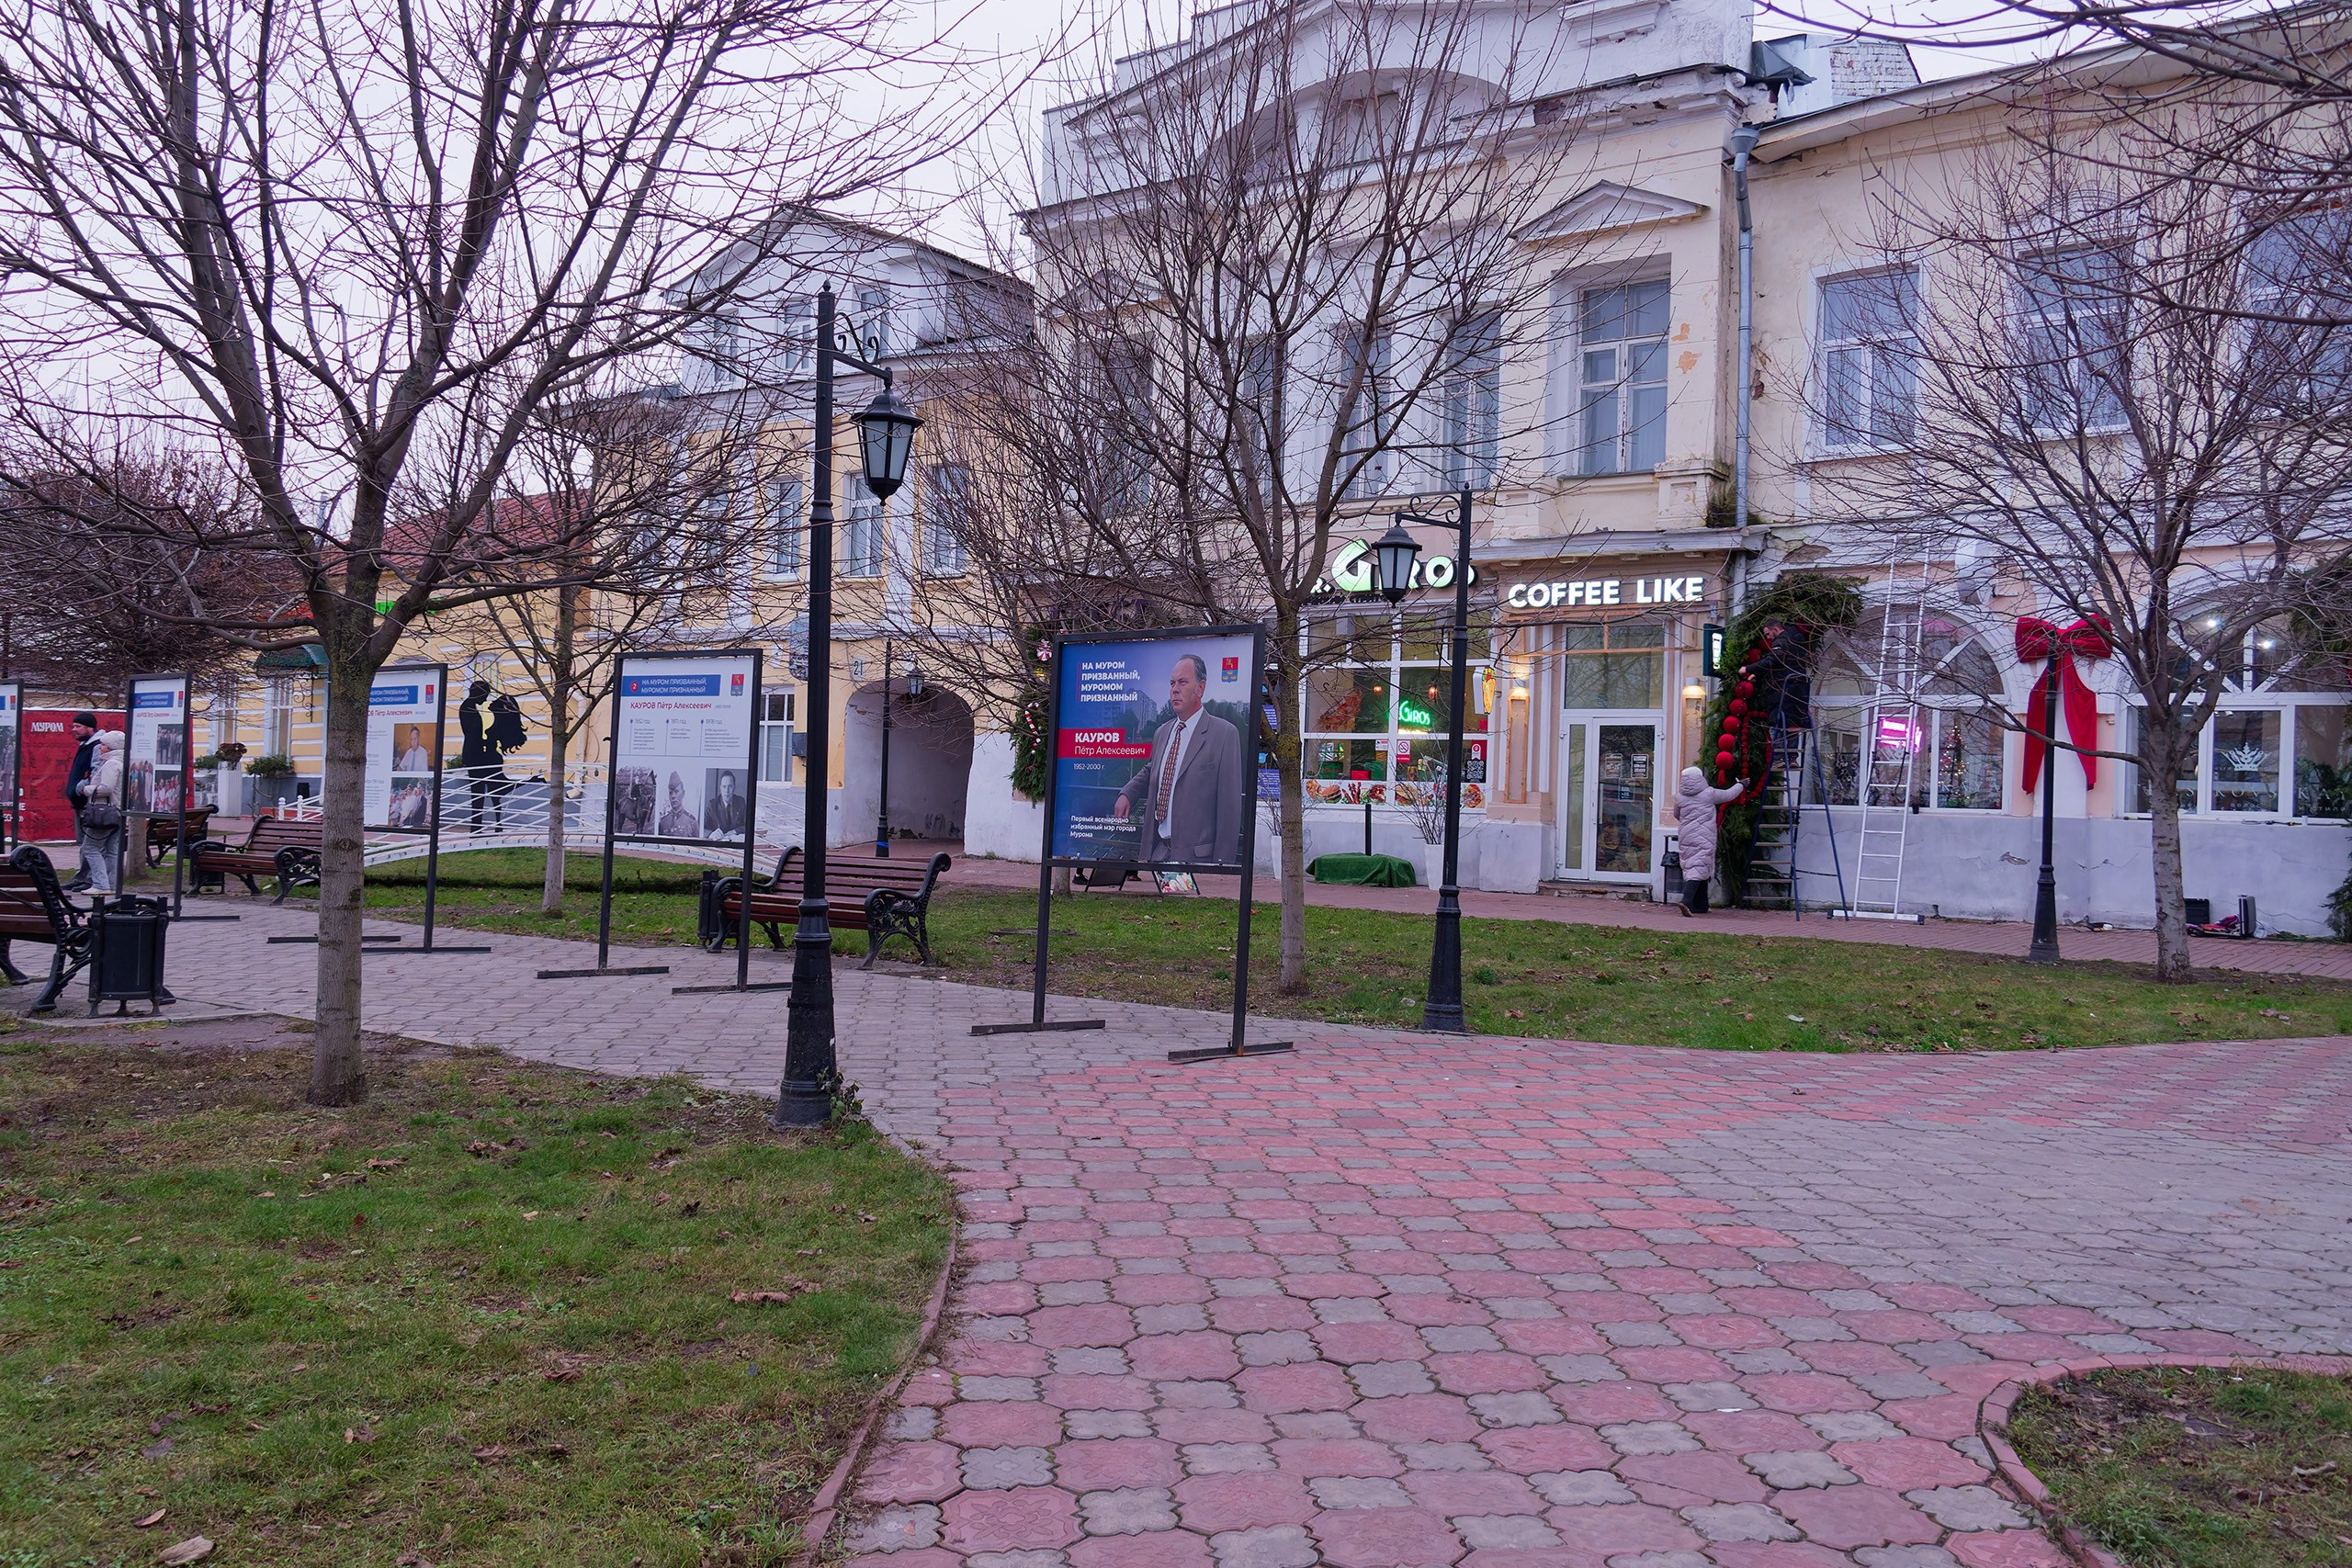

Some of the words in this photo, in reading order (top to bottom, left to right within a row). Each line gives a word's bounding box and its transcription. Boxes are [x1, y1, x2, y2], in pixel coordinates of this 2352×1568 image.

[1508, 580, 1620, 608] COFFEE
[1636, 577, 1704, 604] LIKE
[1095, 661, 1125, 670] МУРОМ
[1081, 671, 1140, 681] ПРИЗВАННЫЙ,
[1080, 692, 1138, 702] ПРИЗНАННЫЙ
[657, 701, 673, 710] Пётр
[1399, 700, 1430, 725] GIROS
[30, 721, 64, 732] МУРОМ
[1075, 732, 1120, 743] КАУРОВ
[1075, 746, 1095, 756] Пётр
[1095, 746, 1146, 754] Алексеевич
[1070, 815, 1093, 823] Первый
[1069, 830, 1093, 839] Мурома
